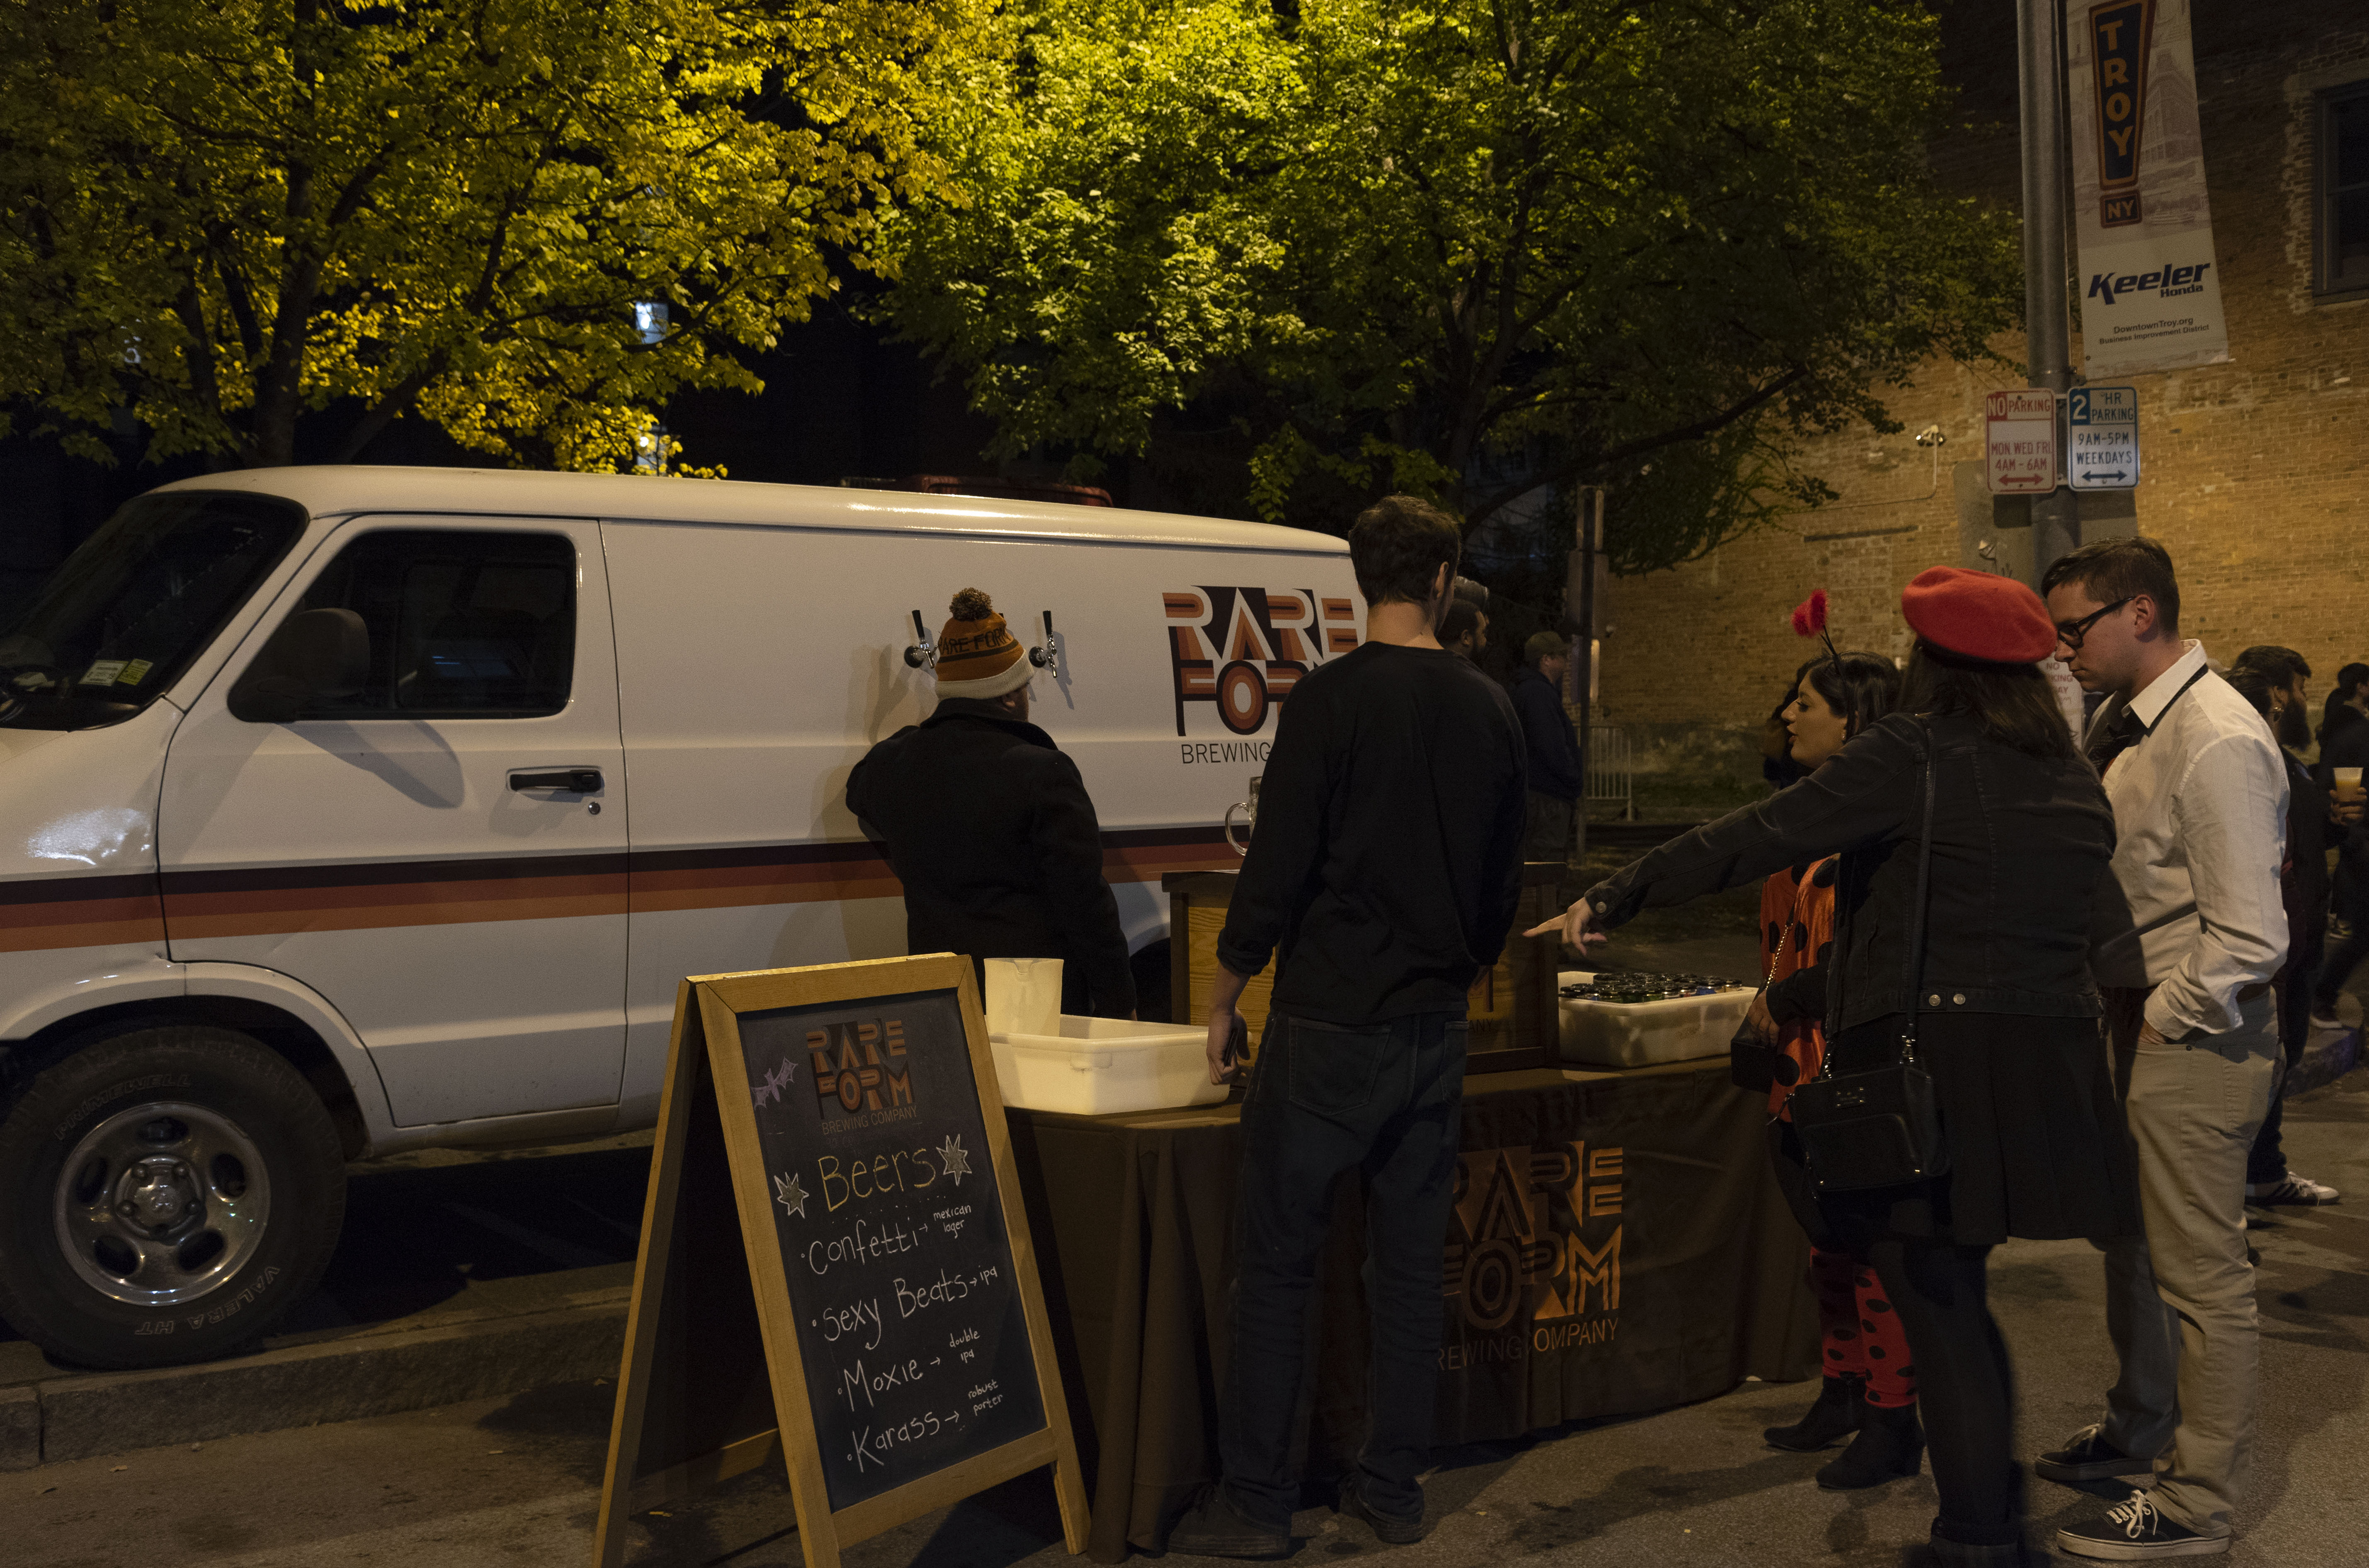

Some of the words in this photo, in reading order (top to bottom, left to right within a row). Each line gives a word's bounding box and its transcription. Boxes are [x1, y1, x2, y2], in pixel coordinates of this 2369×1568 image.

[2100, 19, 2134, 157] TROY
[2107, 199, 2135, 220] NY
[2087, 262, 2211, 305] Keeler
[2160, 283, 2204, 298] Honda
[2099, 336, 2132, 345] Business
[2134, 329, 2181, 340] Improvement
[2183, 324, 2209, 333] District
[2114, 318, 2194, 334] DowntownTroy.org
[1988, 396, 2006, 417] NO
[2008, 399, 2051, 413] PARKING
[2073, 395, 2087, 420] 2
[2104, 392, 2122, 405] HR
[2092, 408, 2134, 421] PARKING
[1991, 442, 2011, 455] MON
[2014, 442, 2033, 454] WED
[2078, 432, 2129, 445] 9AM-5PM
[1995, 459, 2016, 471] 4AM
[2027, 458, 2047, 471] 6AM
[2076, 451, 2132, 465] WEEKDAYS
[1162, 585, 1364, 662] RARE
[1181, 742, 1272, 764] BREWING
[806, 1018, 907, 1075] RARE
[811, 1061, 915, 1119] FORM
[821, 1114, 869, 1135] BREWING
[871, 1105, 918, 1126] COMPANY
[818, 1148, 936, 1212] Beers
[933, 1204, 972, 1221] mexican
[943, 1220, 964, 1239] lager
[809, 1219, 919, 1274] Confetti
[187, 1266, 281, 1330] VALERA
[823, 1298, 882, 1350] Sexy
[893, 1268, 968, 1319] Beats
[979, 1265, 998, 1285] ipa
[134, 1320, 175, 1335] HT
[949, 1328, 980, 1348] double
[1437, 1336, 1521, 1371] REWING
[1534, 1318, 1619, 1352] OMPANY
[844, 1359, 923, 1412] Moxie
[968, 1379, 999, 1400] robust
[973, 1394, 1003, 1416] porter
[852, 1411, 940, 1473] Karass
